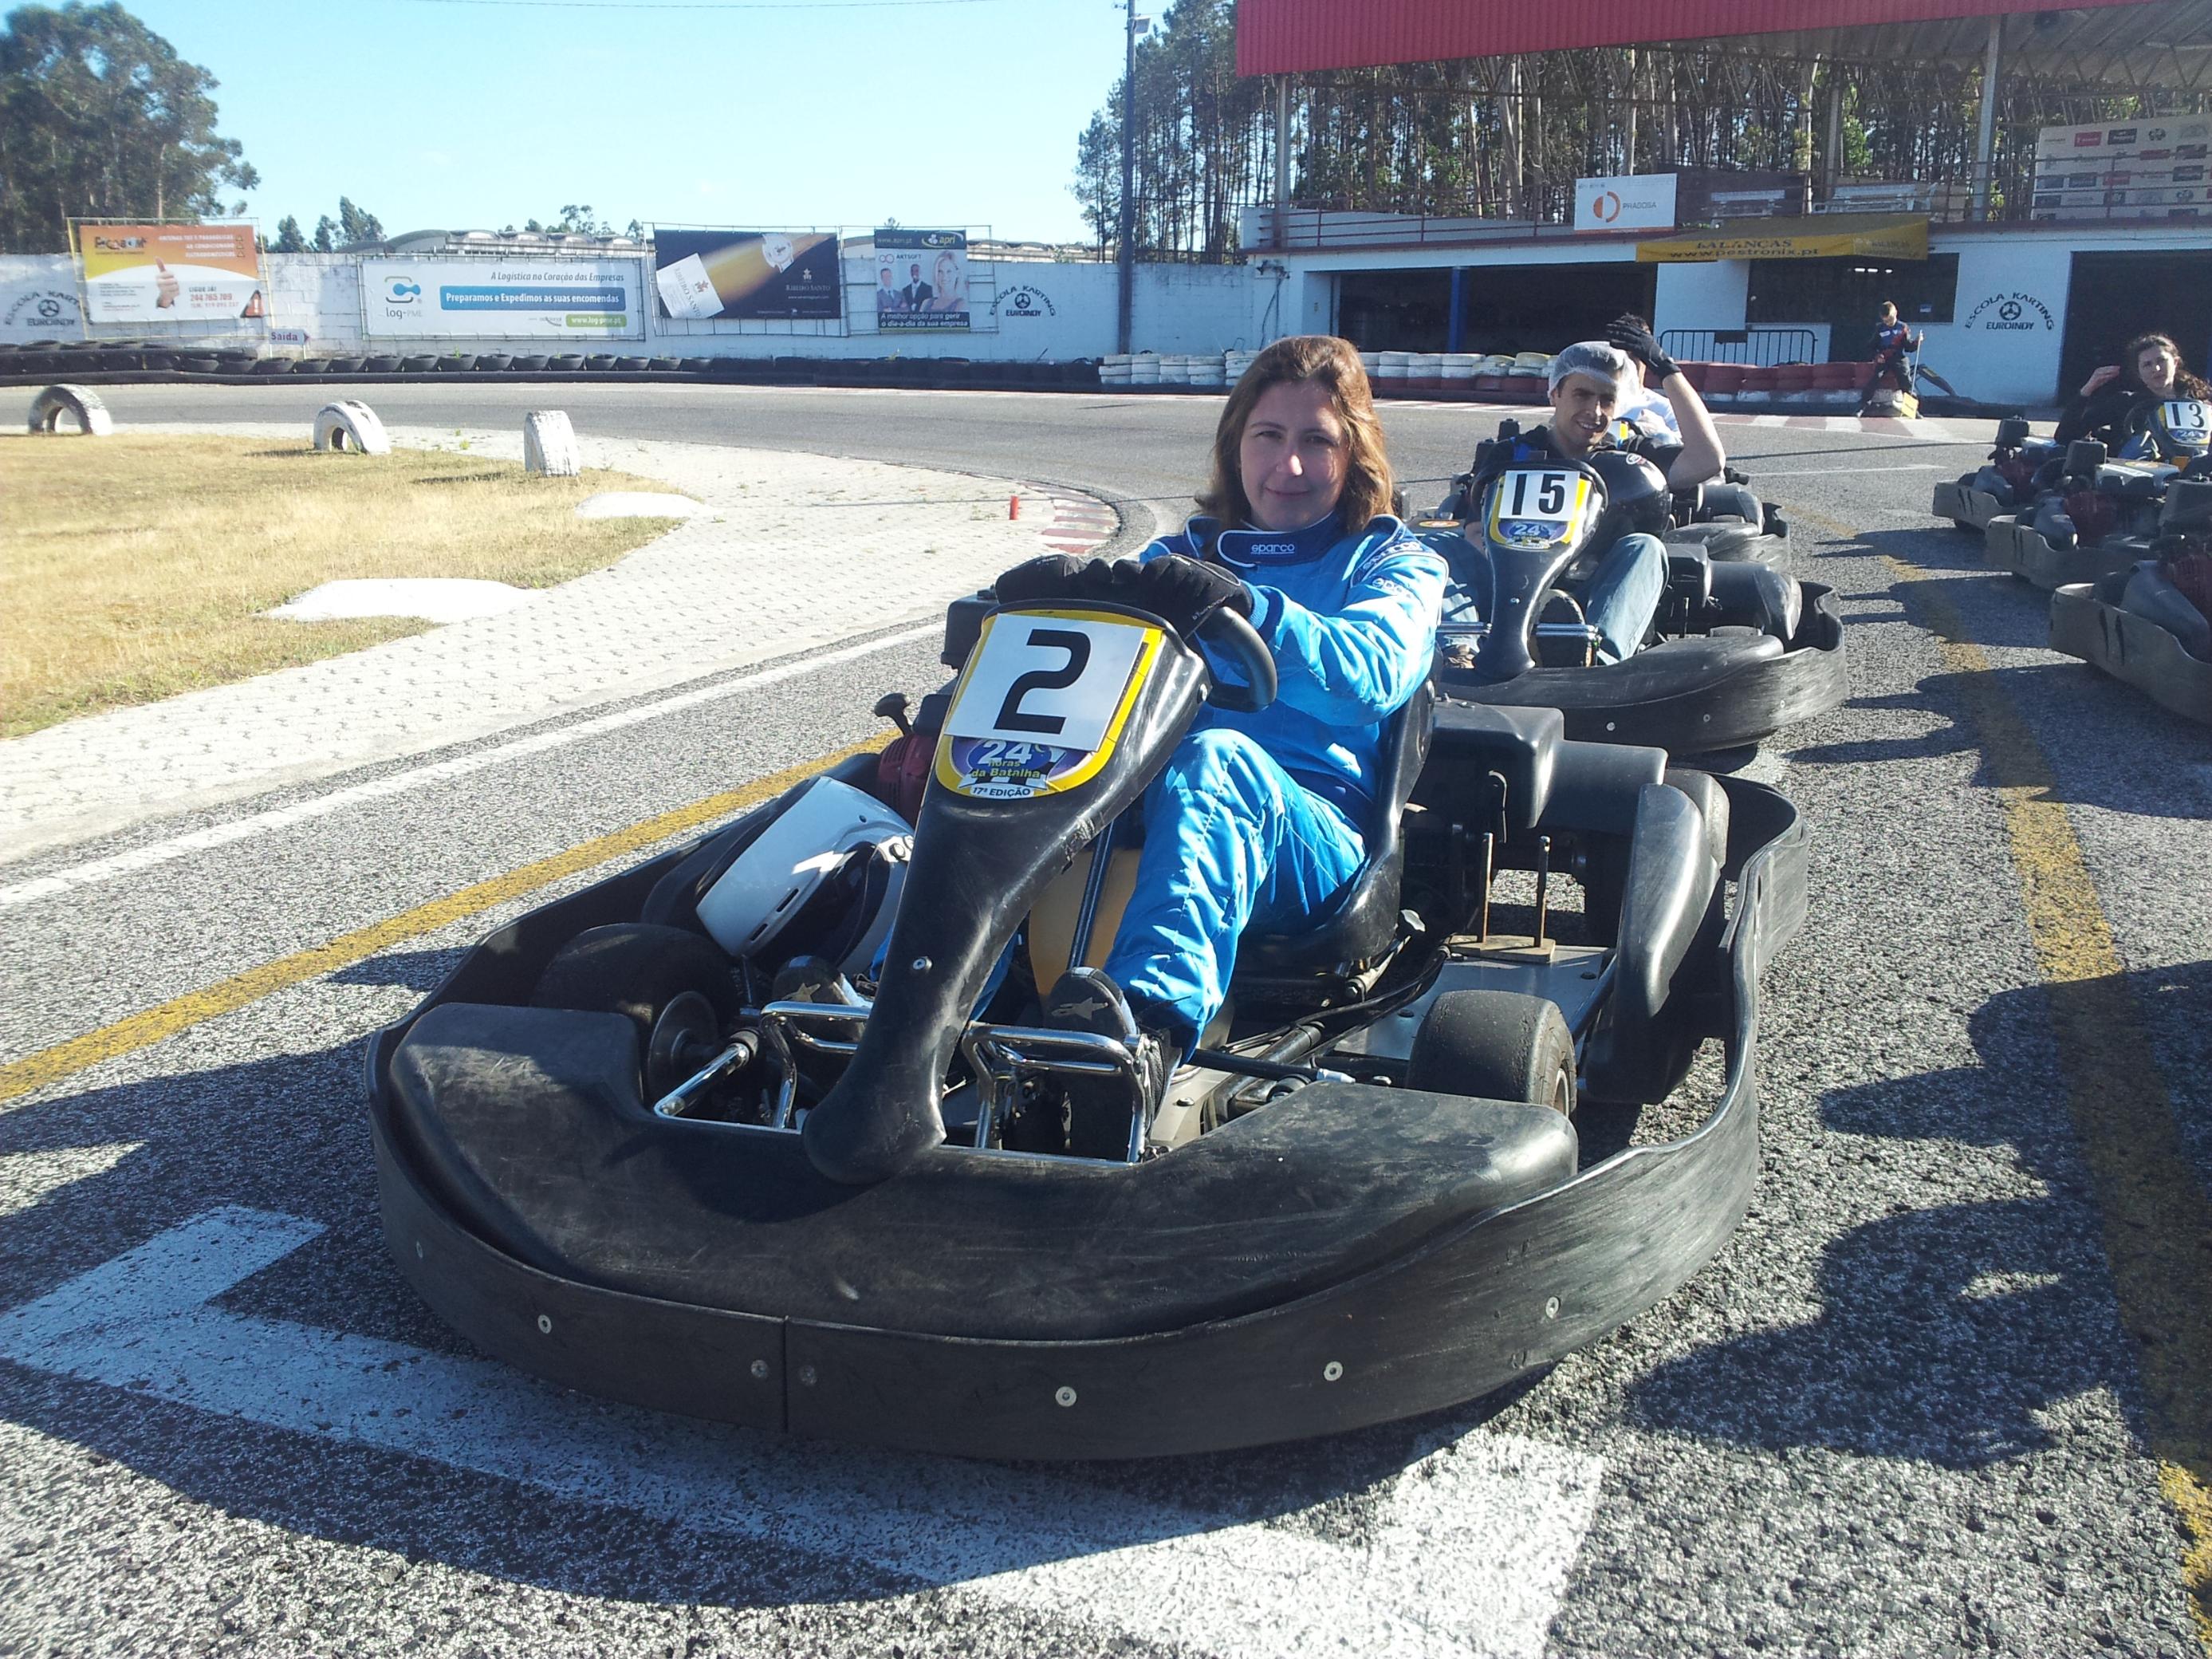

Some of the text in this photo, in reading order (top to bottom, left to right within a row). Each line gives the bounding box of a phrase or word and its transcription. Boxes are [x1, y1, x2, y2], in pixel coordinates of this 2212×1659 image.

[939, 235, 955, 245] apri
[543, 273, 573, 282] Coração
[588, 274, 624, 282] Empresas
[446, 293, 494, 303] Preparamos
[501, 294, 542, 303] Expedimos
[572, 294, 619, 303] encomendas
[990, 286, 1057, 316] ESCOLA KARTING
[1965, 292, 2055, 330] ESCOLA KARTING
[1986, 321, 2034, 330] EUROINDY
[2171, 403, 2205, 428] 13
[1512, 473, 1566, 516] 15
[1513, 524, 1541, 535] 24
[1251, 544, 1295, 554] sparco
[993, 629, 1092, 735] 2
[977, 740, 1033, 764] 24
[971, 767, 1041, 778] da Batalha
[989, 786, 1030, 798] EDIÇÃO
